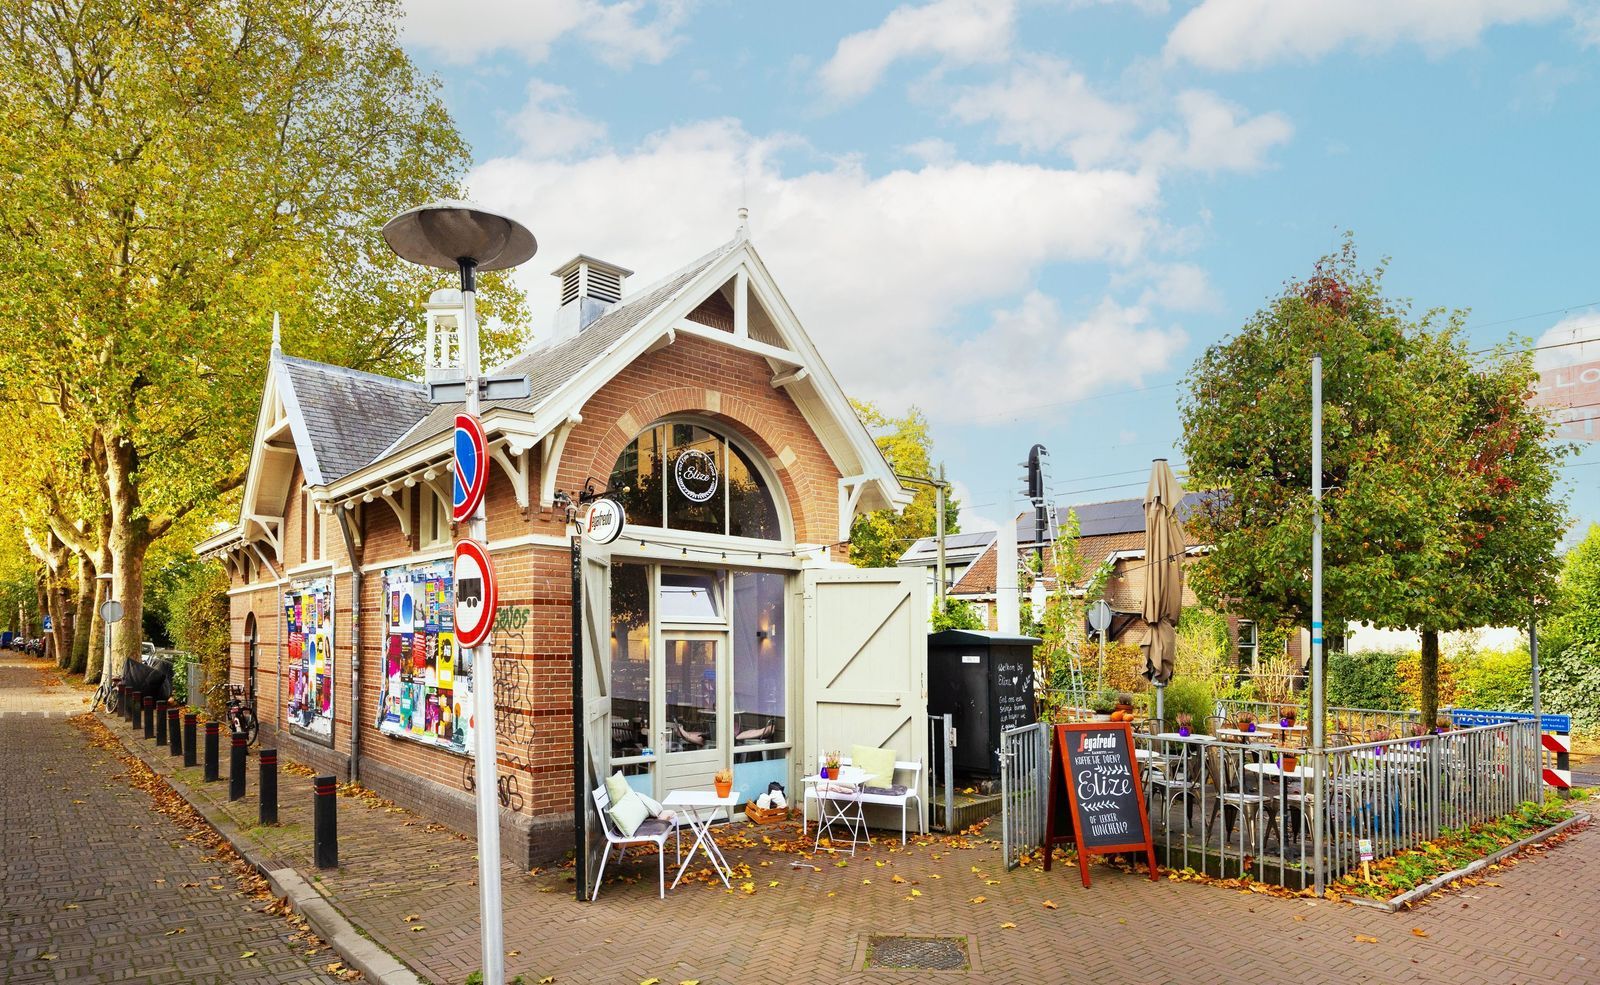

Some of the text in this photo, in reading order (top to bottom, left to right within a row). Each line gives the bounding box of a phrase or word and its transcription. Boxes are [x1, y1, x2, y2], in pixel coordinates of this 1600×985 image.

[684, 466, 710, 481] Elize
[1456, 713, 1502, 724] WACHT
[1077, 733, 1116, 752] Segafredo
[1103, 754, 1120, 764] DOEN?
[1078, 770, 1132, 800] Elize
[1090, 813, 1118, 824] OF LEKKER
[1092, 822, 1128, 836] LUNCHEN?
